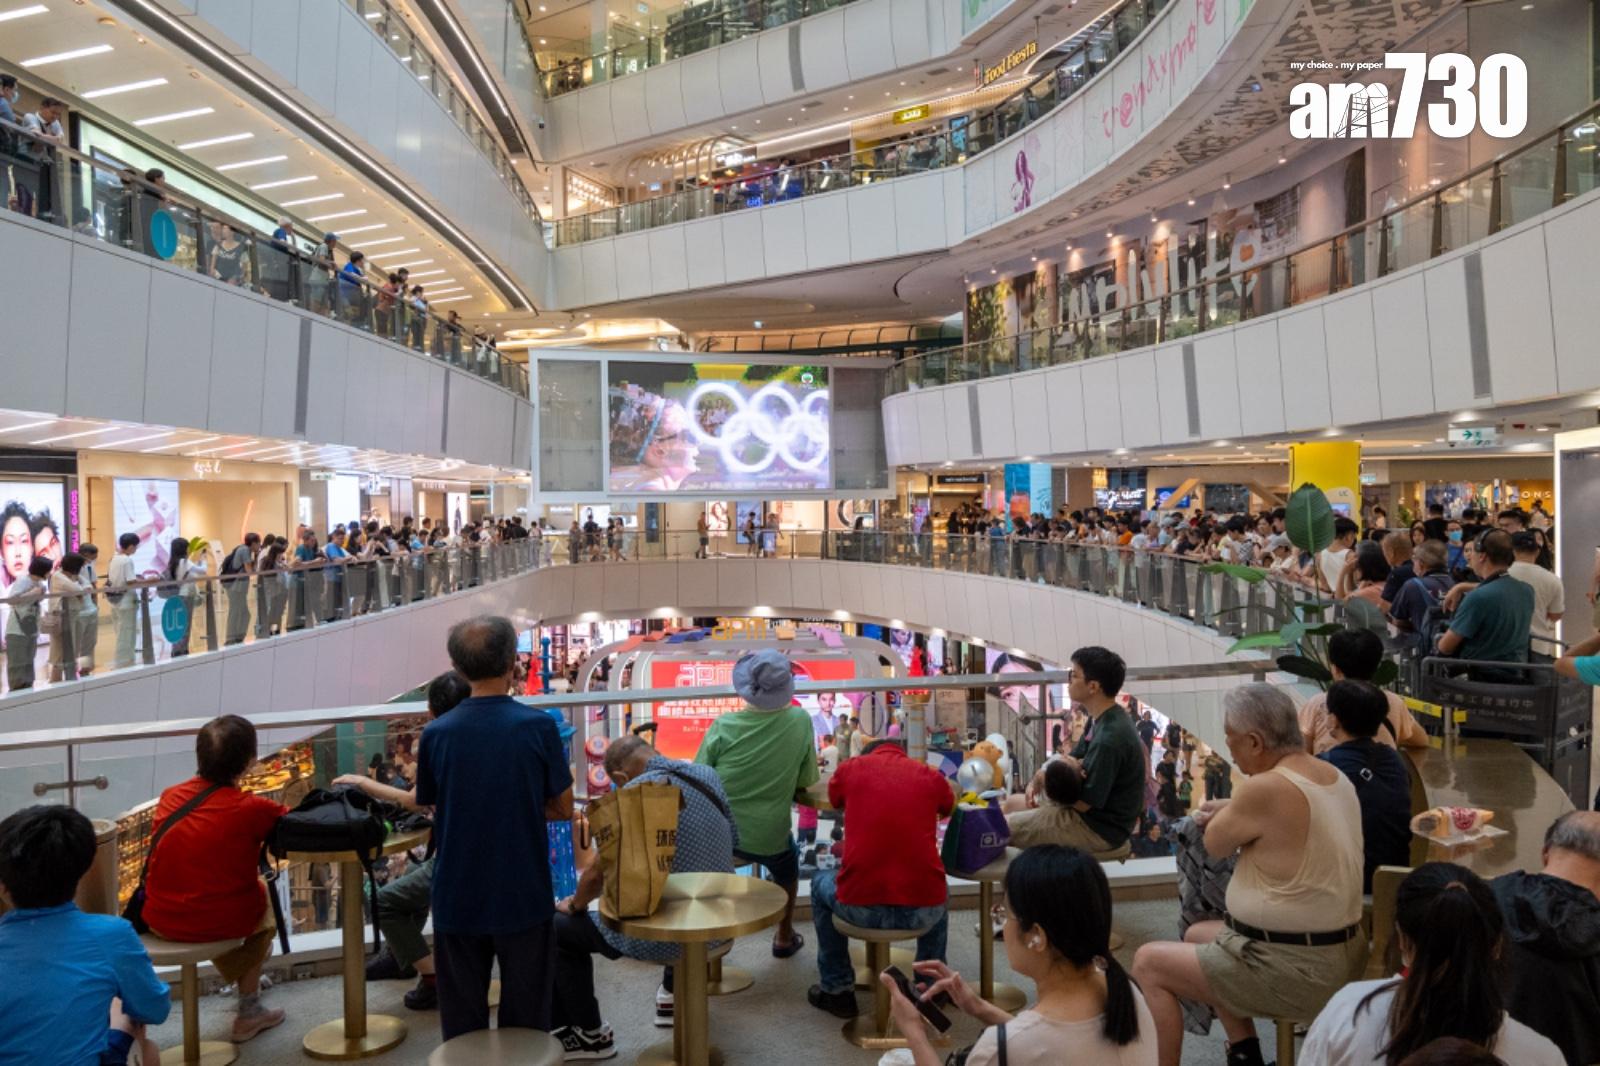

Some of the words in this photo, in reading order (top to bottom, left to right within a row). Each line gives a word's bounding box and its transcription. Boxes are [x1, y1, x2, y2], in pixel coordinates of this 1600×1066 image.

[984, 58, 1006, 84] Food
[1007, 41, 1037, 70] Fiesta
[166, 608, 184, 631] UC
